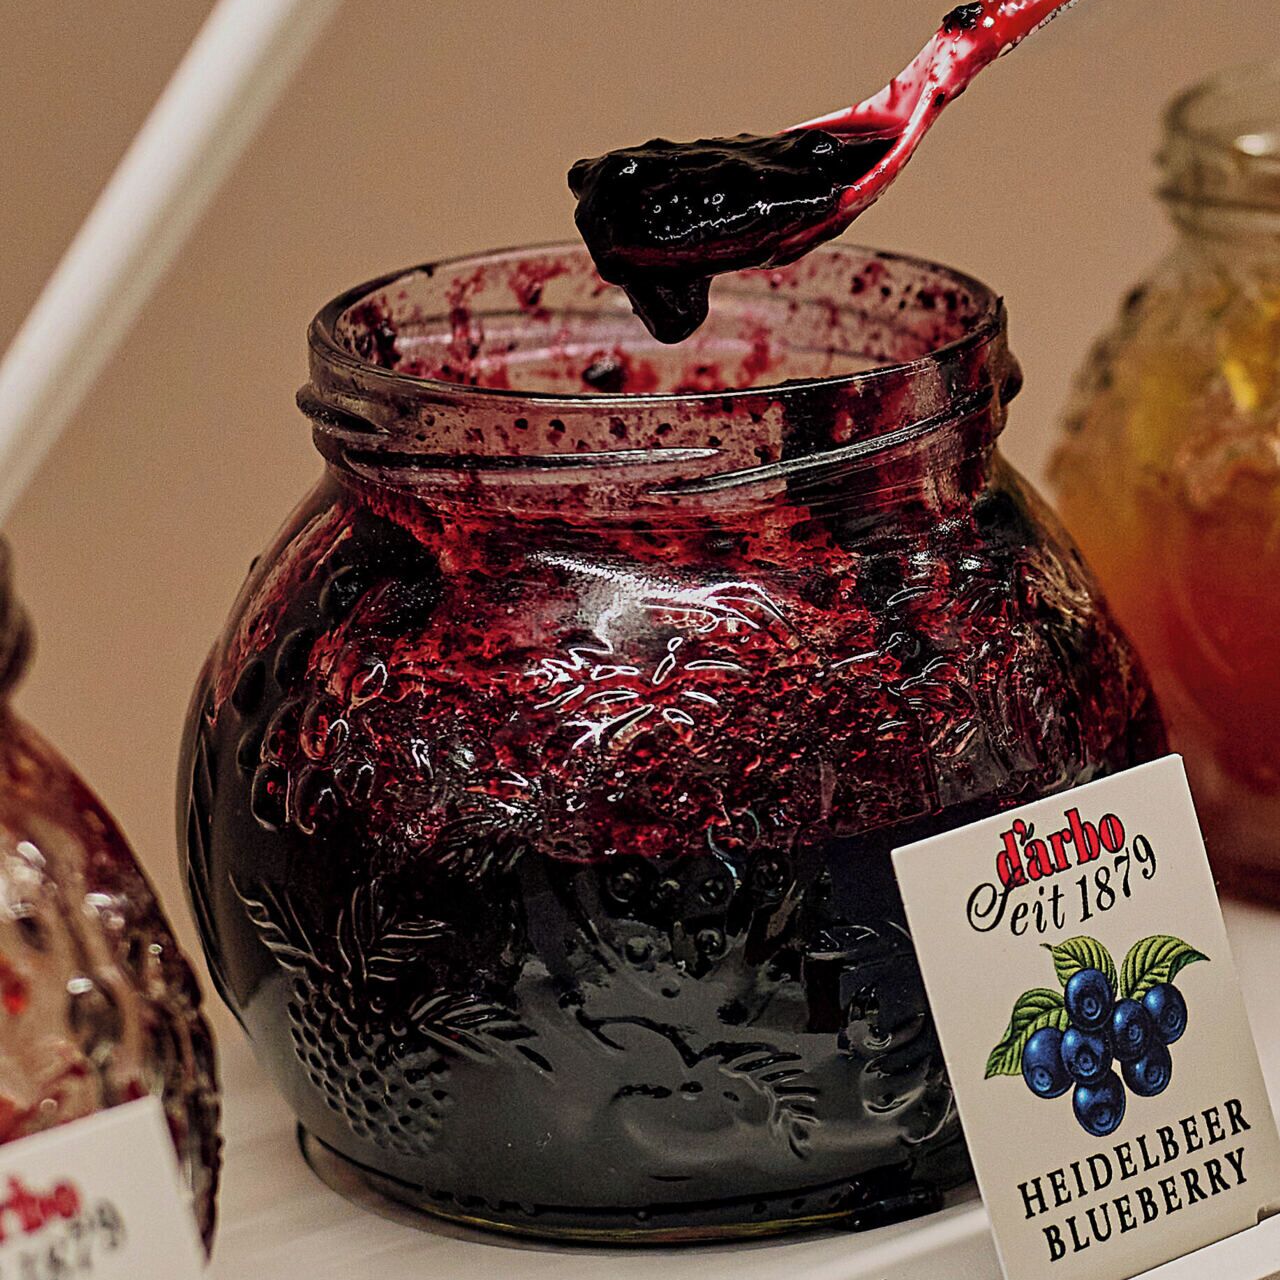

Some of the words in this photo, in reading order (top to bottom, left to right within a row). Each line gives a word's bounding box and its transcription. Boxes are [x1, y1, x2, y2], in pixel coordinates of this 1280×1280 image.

[966, 875, 1065, 936] Seit
[1075, 834, 1157, 923] 1879
[1016, 1097, 1252, 1220] HEIDELBEER
[1041, 1146, 1249, 1263] BLUEBERRY
